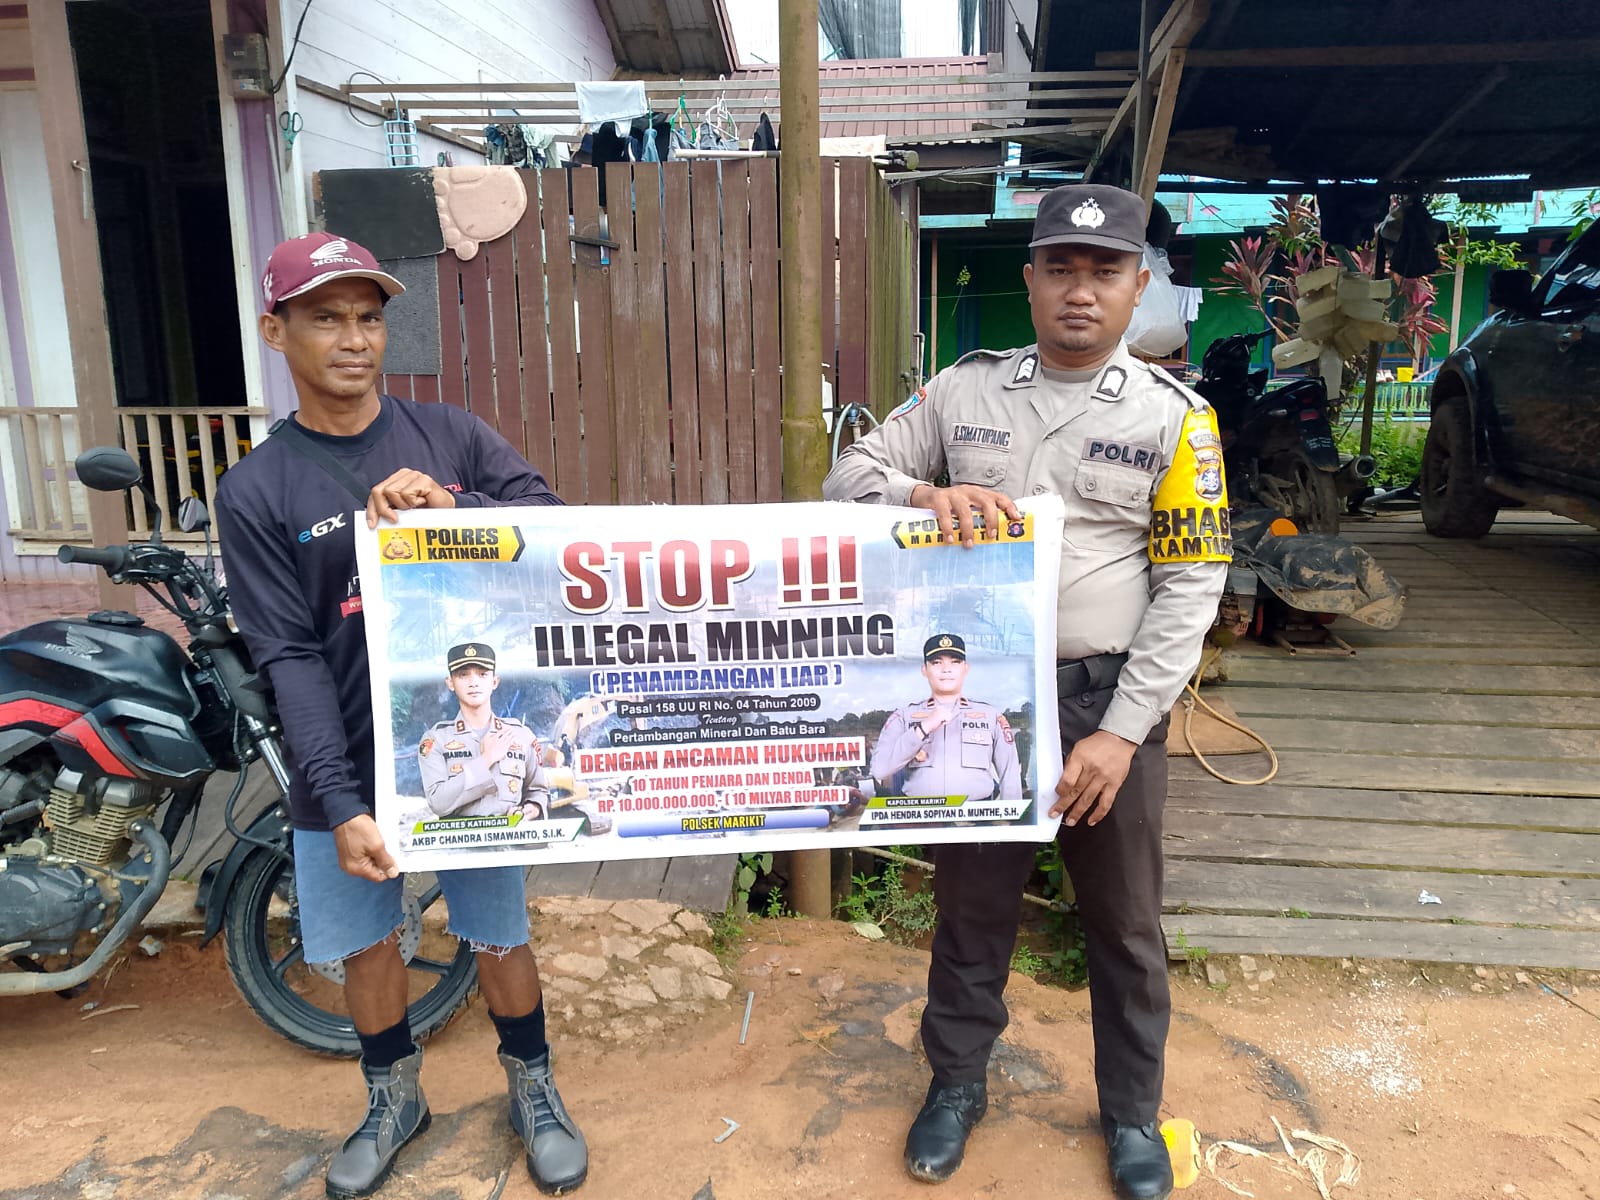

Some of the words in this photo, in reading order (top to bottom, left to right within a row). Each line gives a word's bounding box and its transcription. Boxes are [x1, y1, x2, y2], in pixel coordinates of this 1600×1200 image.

[312, 257, 363, 267] HONDA
[1089, 441, 1157, 471] POLRI
[297, 513, 347, 543] eGX
[425, 527, 499, 546] POLRES
[427, 546, 500, 560] KATINGAN
[562, 539, 751, 611] STOP
[782, 535, 858, 603] !!!
[534, 623, 696, 667] ILLEGAL
[706, 613, 894, 662] MINNING
[44, 643, 93, 661] HONDA
[621, 704, 653, 715] Pasal
[655, 703, 675, 713] 158
[678, 701, 696, 712] UU
[699, 701, 711, 711] RI
[714, 700, 733, 710] No.
[736, 700, 750, 709] 04
[752, 699, 787, 709] Tahun
[790, 697, 817, 708] 2009
[702, 714, 738, 725] Tentang
[962, 721, 990, 730] POLRI
[614, 731, 697, 743] Pertambangan
[700, 728, 742, 739] Mineral
[744, 726, 767, 736] Dan
[770, 725, 796, 736] Batu
[799, 724, 826, 735] Bara
[580, 751, 658, 773] DENGAN
[662, 746, 759, 769] ANCAMAN
[763, 742, 861, 765] HUKUMAN
[632, 778, 646, 792] 10
[648, 776, 689, 791] TAHUN
[691, 774, 743, 788] PENJARA
[745, 772, 770, 786] DAN
[772, 771, 813, 785] DENDA
[598, 800, 616, 813] RP.
[732, 792, 746, 806] 10
[749, 791, 792, 805] MILYAR
[794, 789, 839, 803] RUPIAH
[920, 798, 946, 806] MARIKIT
[871, 811, 889, 820] IPDA
[890, 810, 921, 820] HENDRA
[923, 808, 956, 819] SOPIYAN
[958, 808, 966, 818] D.
[967, 807, 1003, 818] MUNTHE,
[1004, 807, 1019, 817] S.H.
[423, 822, 466, 831] KAPOLRES
[467, 818, 509, 829] KATINGAN
[682, 817, 721, 831] POLSEK
[723, 815, 766, 829] MARIKIT
[412, 836, 437, 847] AKBP
[439, 834, 482, 845] CHANDRA
[484, 831, 540, 842] ISMAWANTO,
[542, 828, 566, 838] S.I.K.
